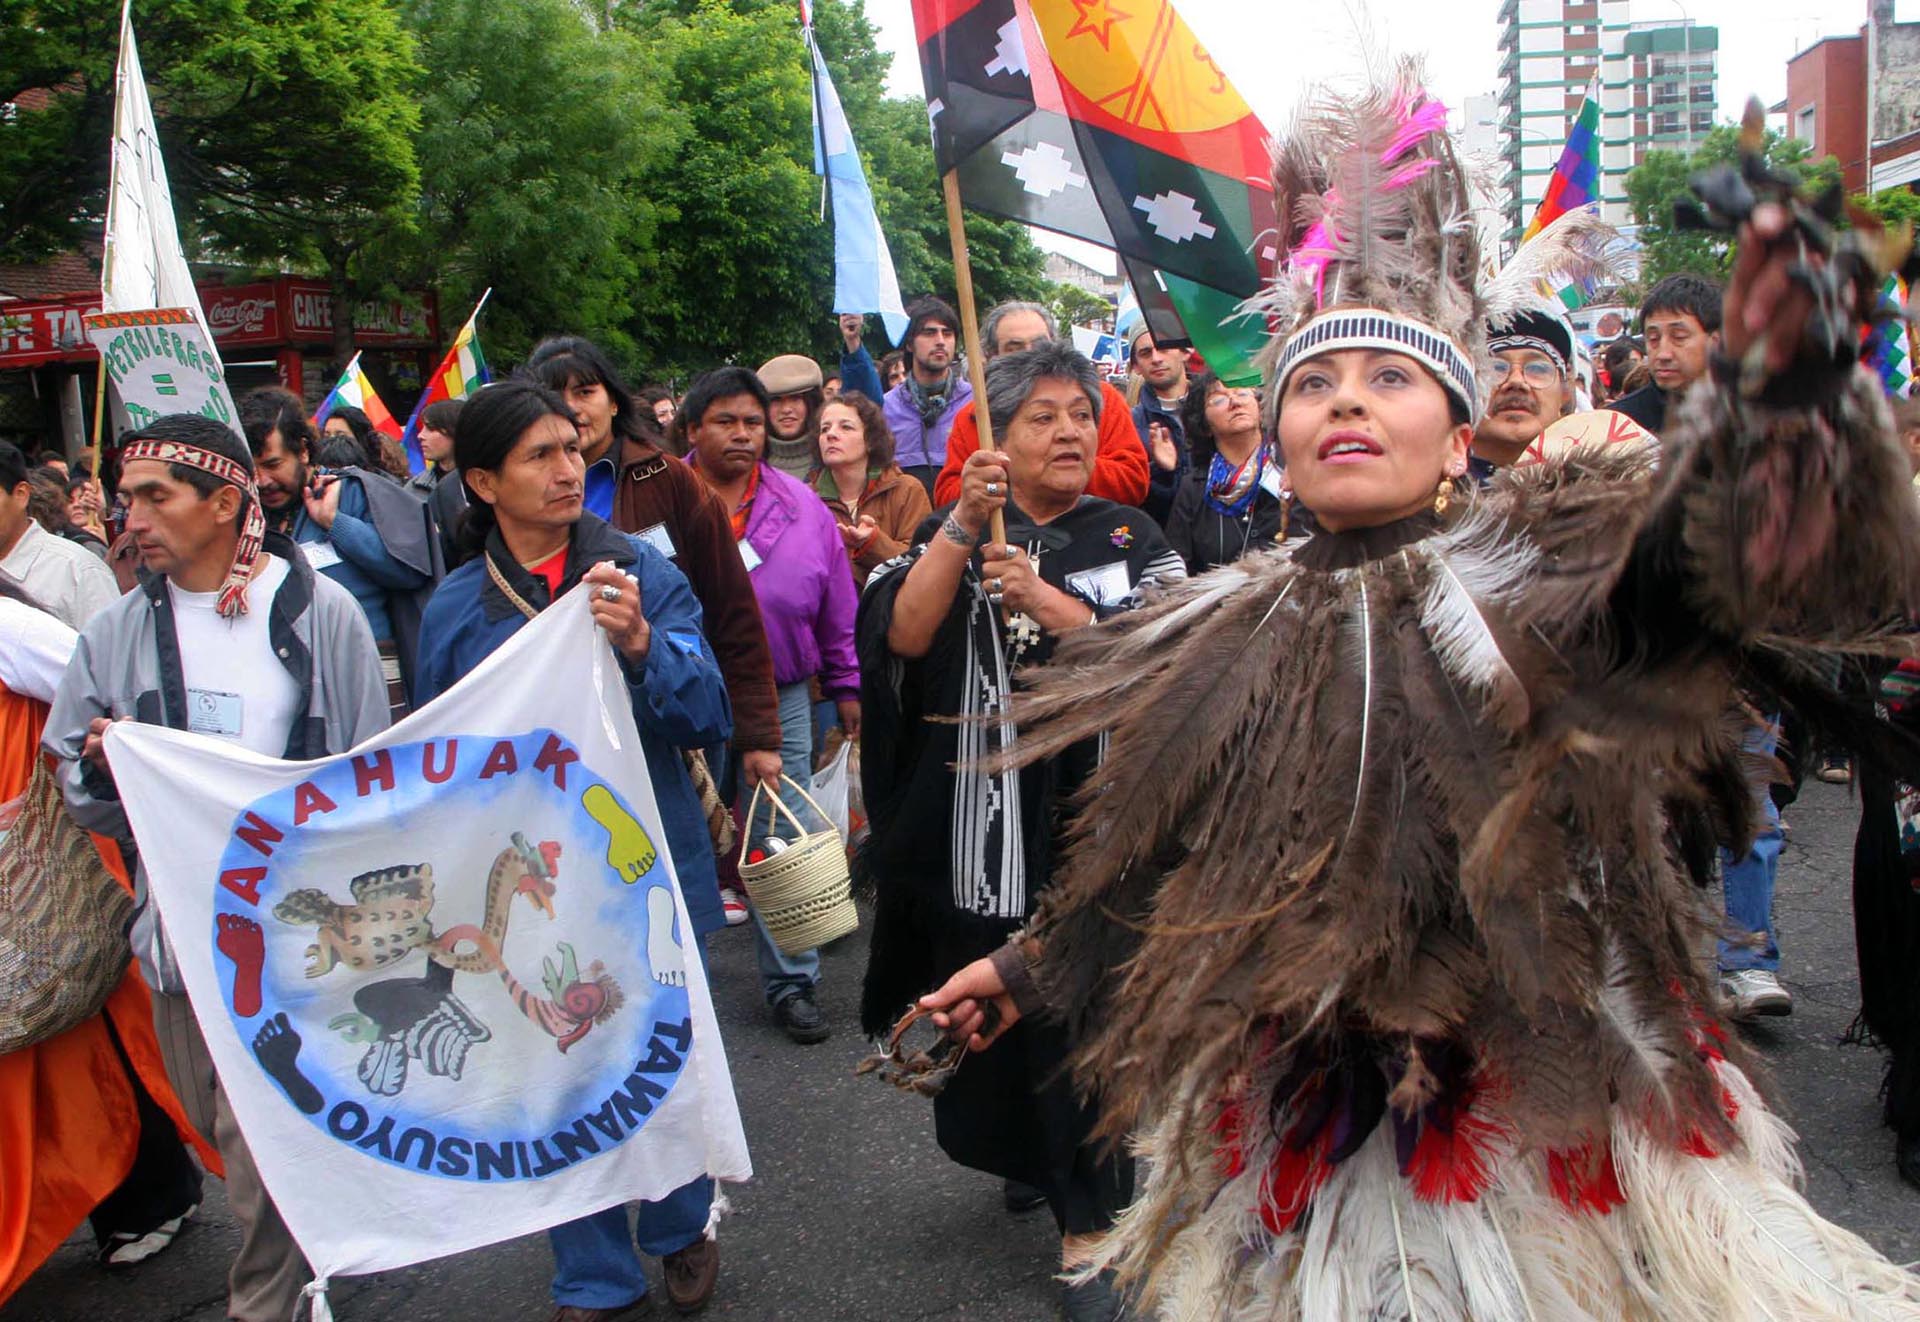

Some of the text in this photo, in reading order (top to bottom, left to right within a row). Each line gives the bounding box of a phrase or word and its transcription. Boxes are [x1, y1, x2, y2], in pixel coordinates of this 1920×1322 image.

[104, 327, 220, 383] PETROLERAS
[219, 733, 580, 907] ANAHUAK
[327, 1017, 693, 1180] TAWANTINSUYO
